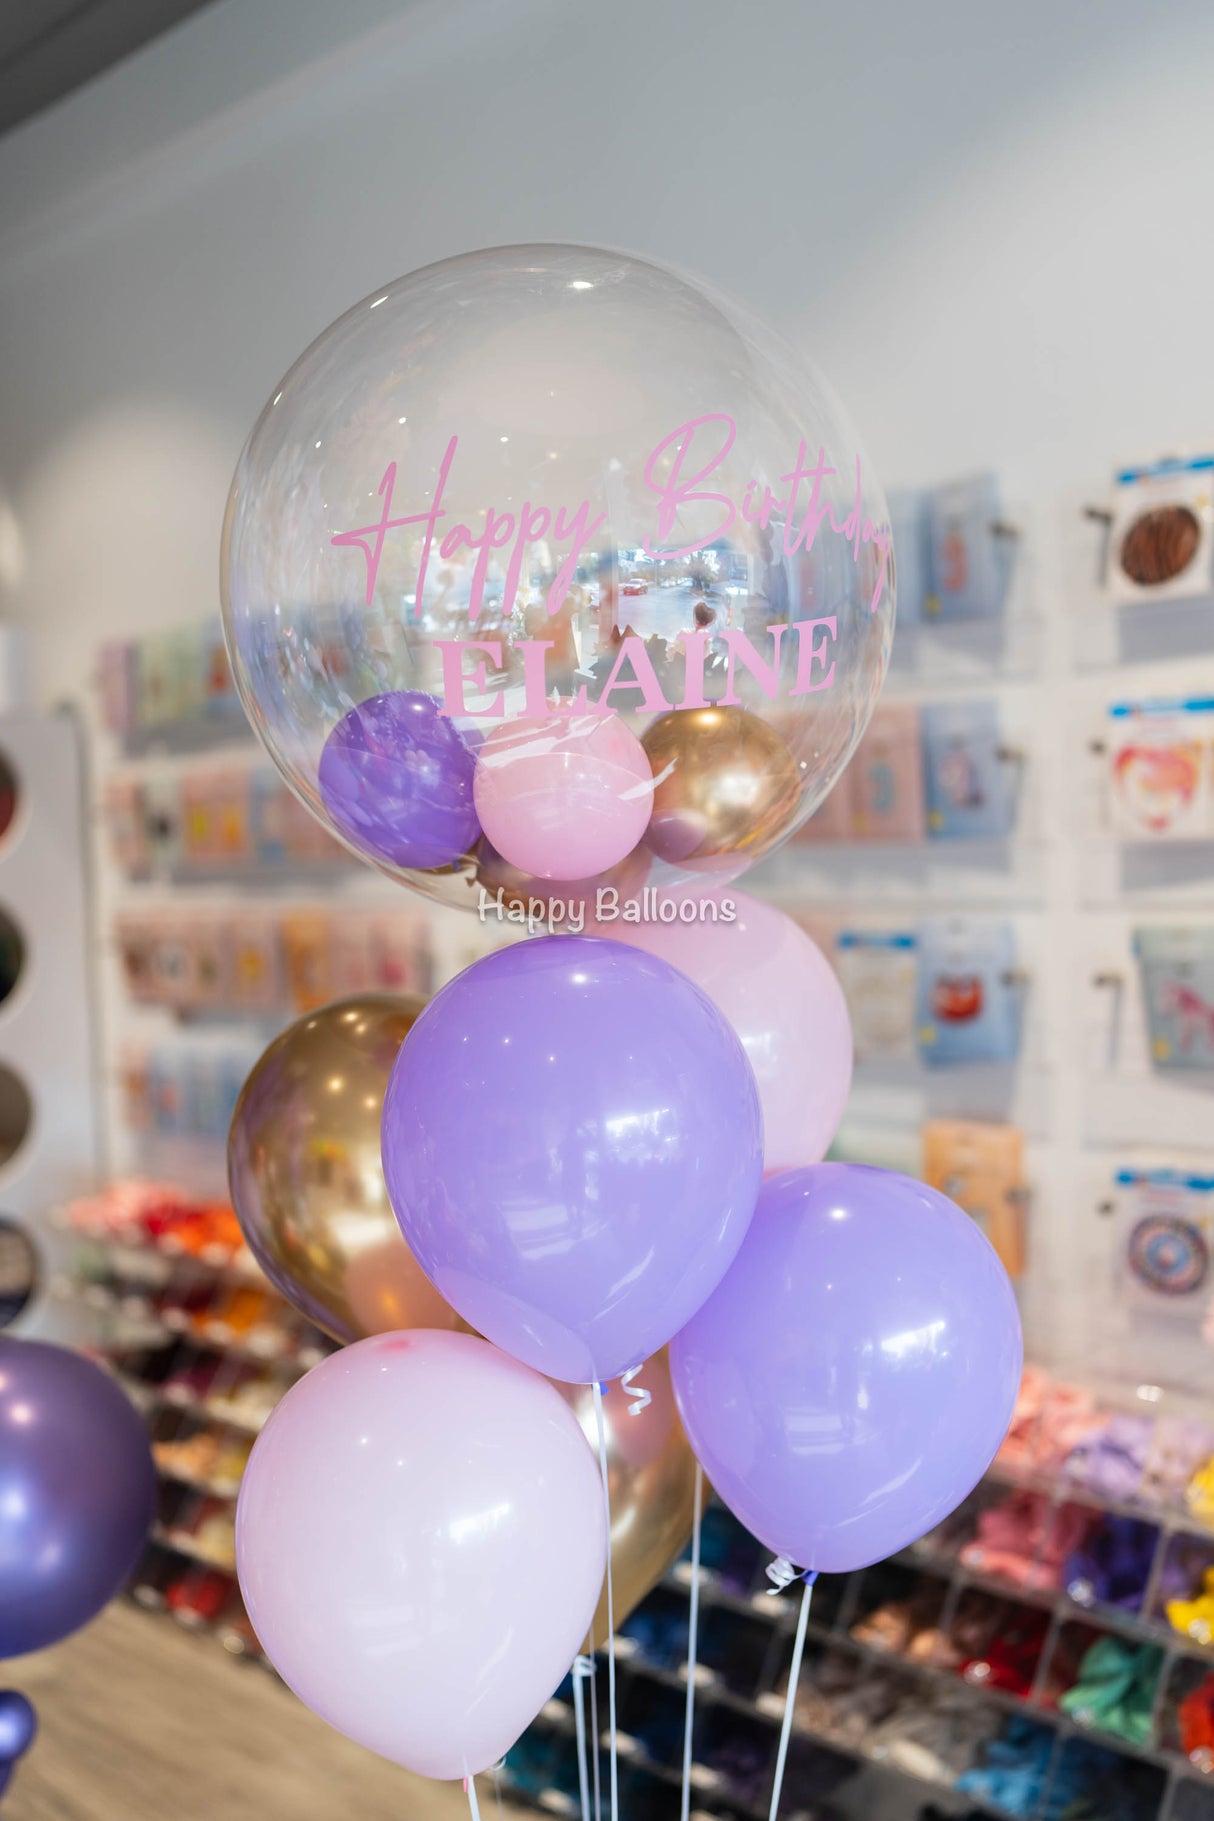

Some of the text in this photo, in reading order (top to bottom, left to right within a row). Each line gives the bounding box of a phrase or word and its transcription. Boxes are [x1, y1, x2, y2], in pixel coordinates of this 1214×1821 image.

[331, 413, 889, 620] Happy Birthday
[433, 615, 837, 718] ELAINE
